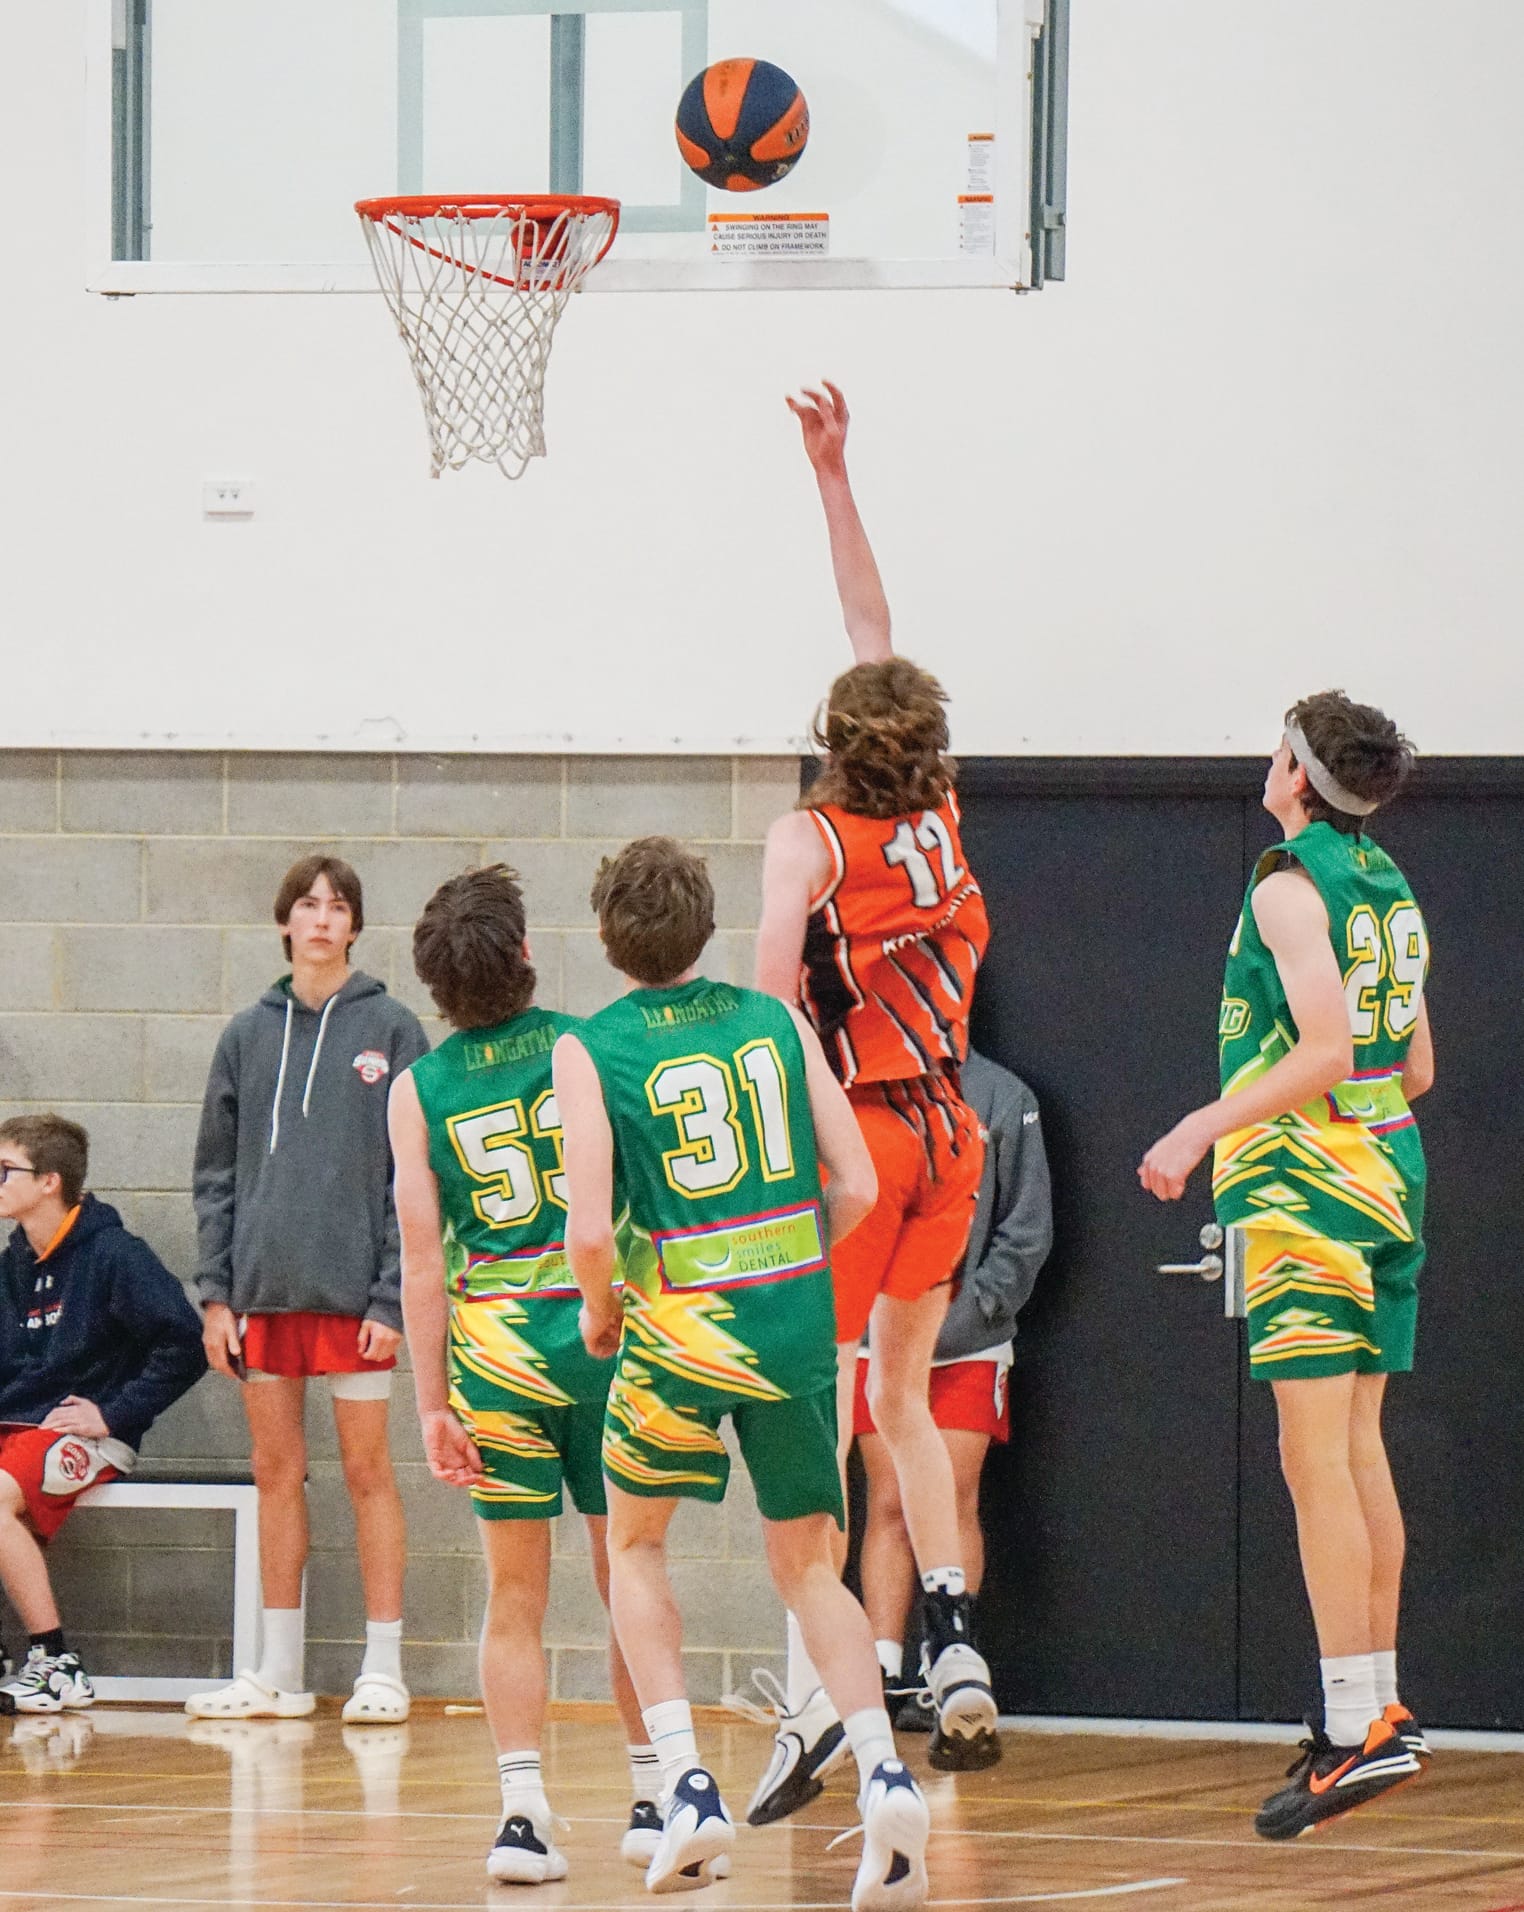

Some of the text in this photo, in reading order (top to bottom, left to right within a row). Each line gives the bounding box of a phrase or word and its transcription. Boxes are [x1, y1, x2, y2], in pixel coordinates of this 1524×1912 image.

[881, 808, 966, 908] 12
[1344, 900, 1430, 1046] 29
[644, 1037, 796, 1200] 31
[731, 1223, 797, 1246] southern
[736, 1241, 783, 1259] smiles
[738, 1252, 794, 1273] DENTAL
